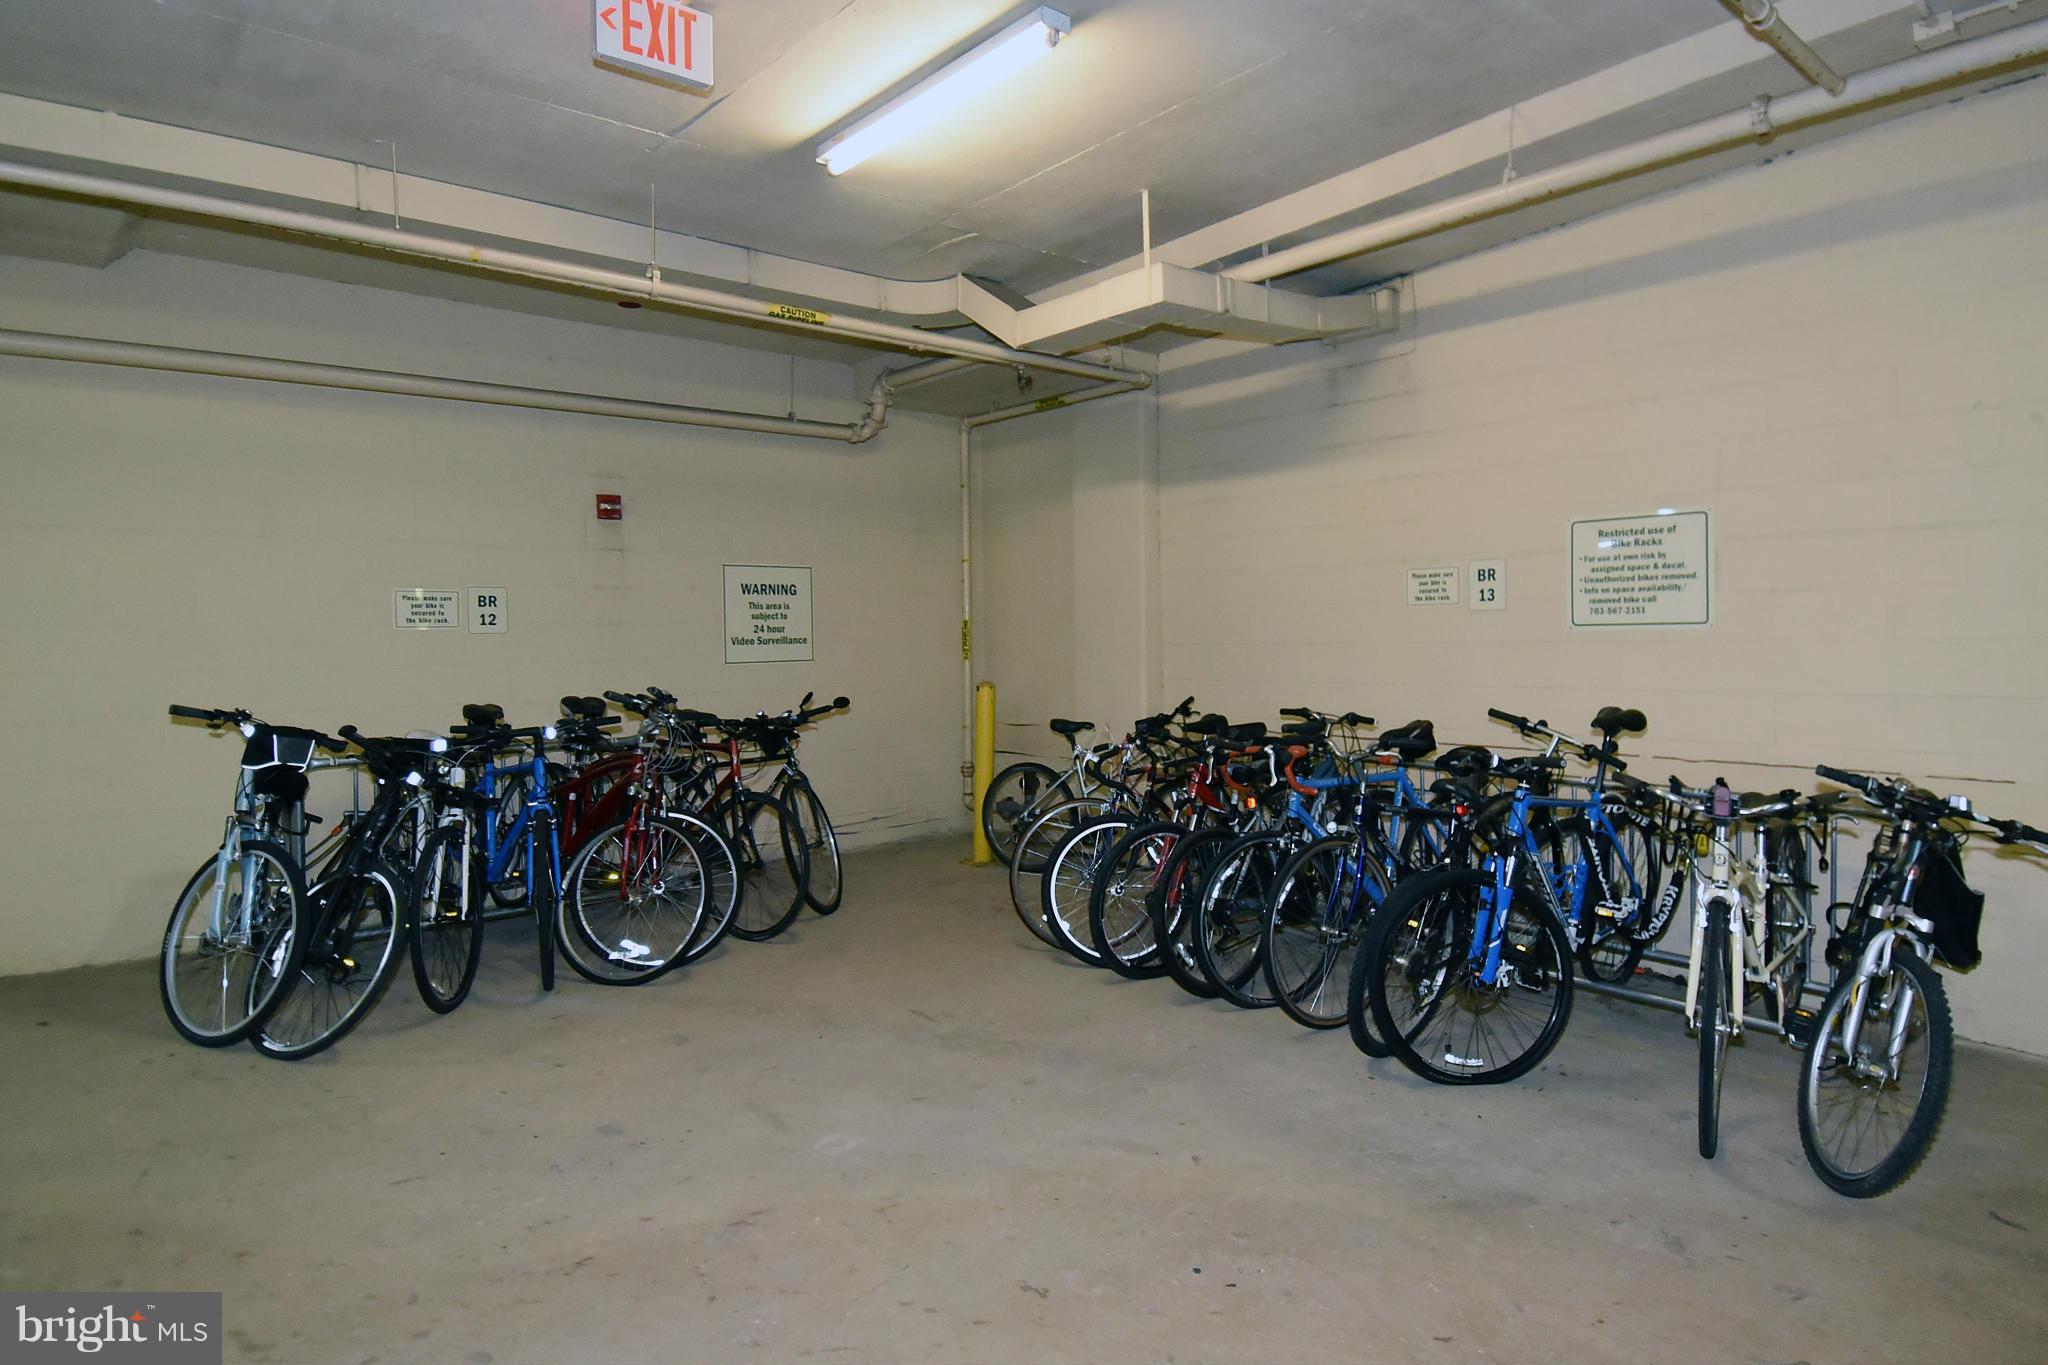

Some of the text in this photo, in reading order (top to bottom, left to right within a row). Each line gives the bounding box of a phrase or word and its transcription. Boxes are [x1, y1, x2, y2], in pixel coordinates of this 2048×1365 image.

[622, 0, 697, 71] EXIT
[780, 306, 816, 320] CAUTION
[1598, 525, 1676, 538] Restricted use of
[1634, 537, 1663, 547] Racks
[1657, 551, 1667, 560] by
[1591, 564, 1625, 574] assigned
[1627, 564, 1651, 572] space
[1477, 568, 1496, 582] BR
[1584, 575, 1635, 584] Unauthorized
[1637, 573, 1659, 581] bikes
[740, 583, 797, 595] WARNING
[1584, 586, 1599, 594] Info
[1612, 586, 1636, 594] space
[1479, 588, 1495, 602] 13
[477, 595, 498, 608] BR
[1588, 596, 1621, 605] removed
[748, 602, 763, 610] This
[783, 602, 790, 610] is
[479, 613, 497, 626] 12
[751, 612, 788, 622] subject to
[753, 625, 786, 633] 24 hour
[731, 636, 808, 646] Video Surveillance
